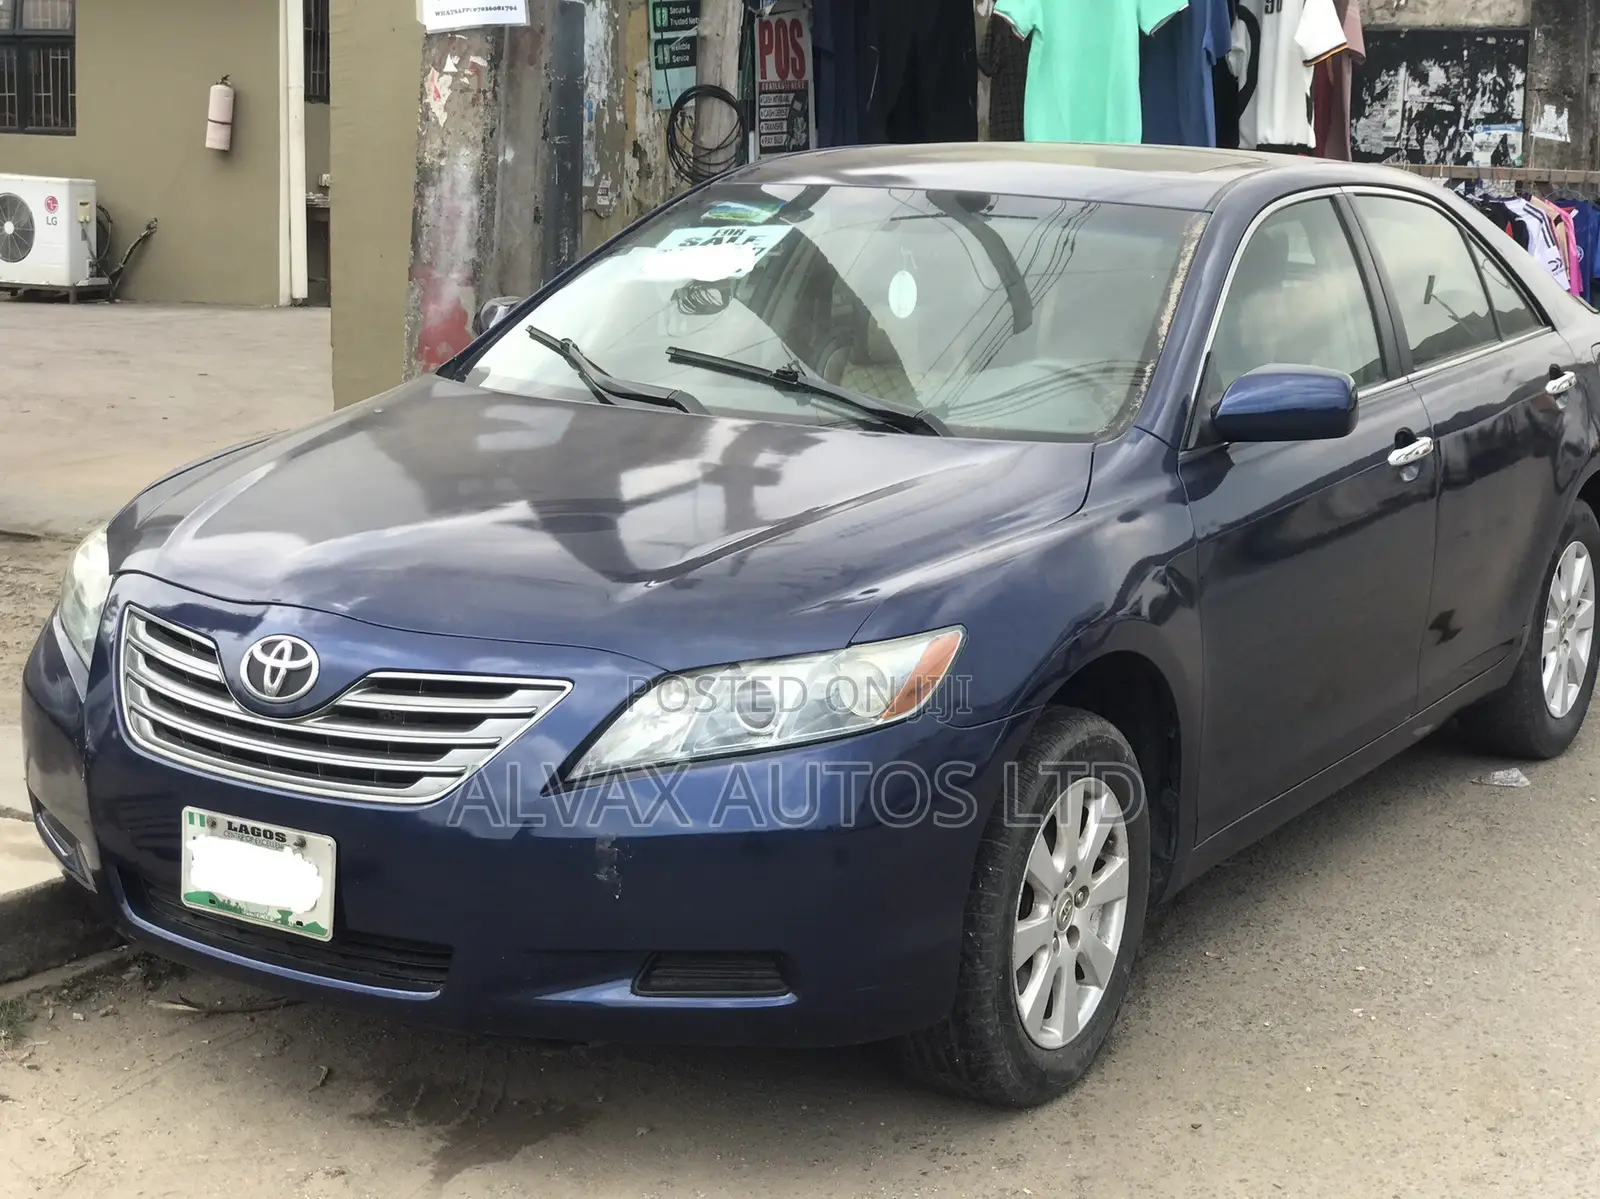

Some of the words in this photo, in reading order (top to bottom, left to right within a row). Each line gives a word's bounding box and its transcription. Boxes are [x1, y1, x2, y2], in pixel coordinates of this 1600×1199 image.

[670, 6, 686, 14] Secure
[686, 5, 691, 14] &
[670, 18, 689, 26] Trusted
[758, 18, 807, 80] POS
[672, 55, 690, 63] Service
[46, 216, 58, 226] LG
[712, 228, 747, 237] FOR
[678, 235, 766, 247] SALE
[227, 821, 287, 843] LAGOS
[255, 838, 290, 851] EXCELLEN
